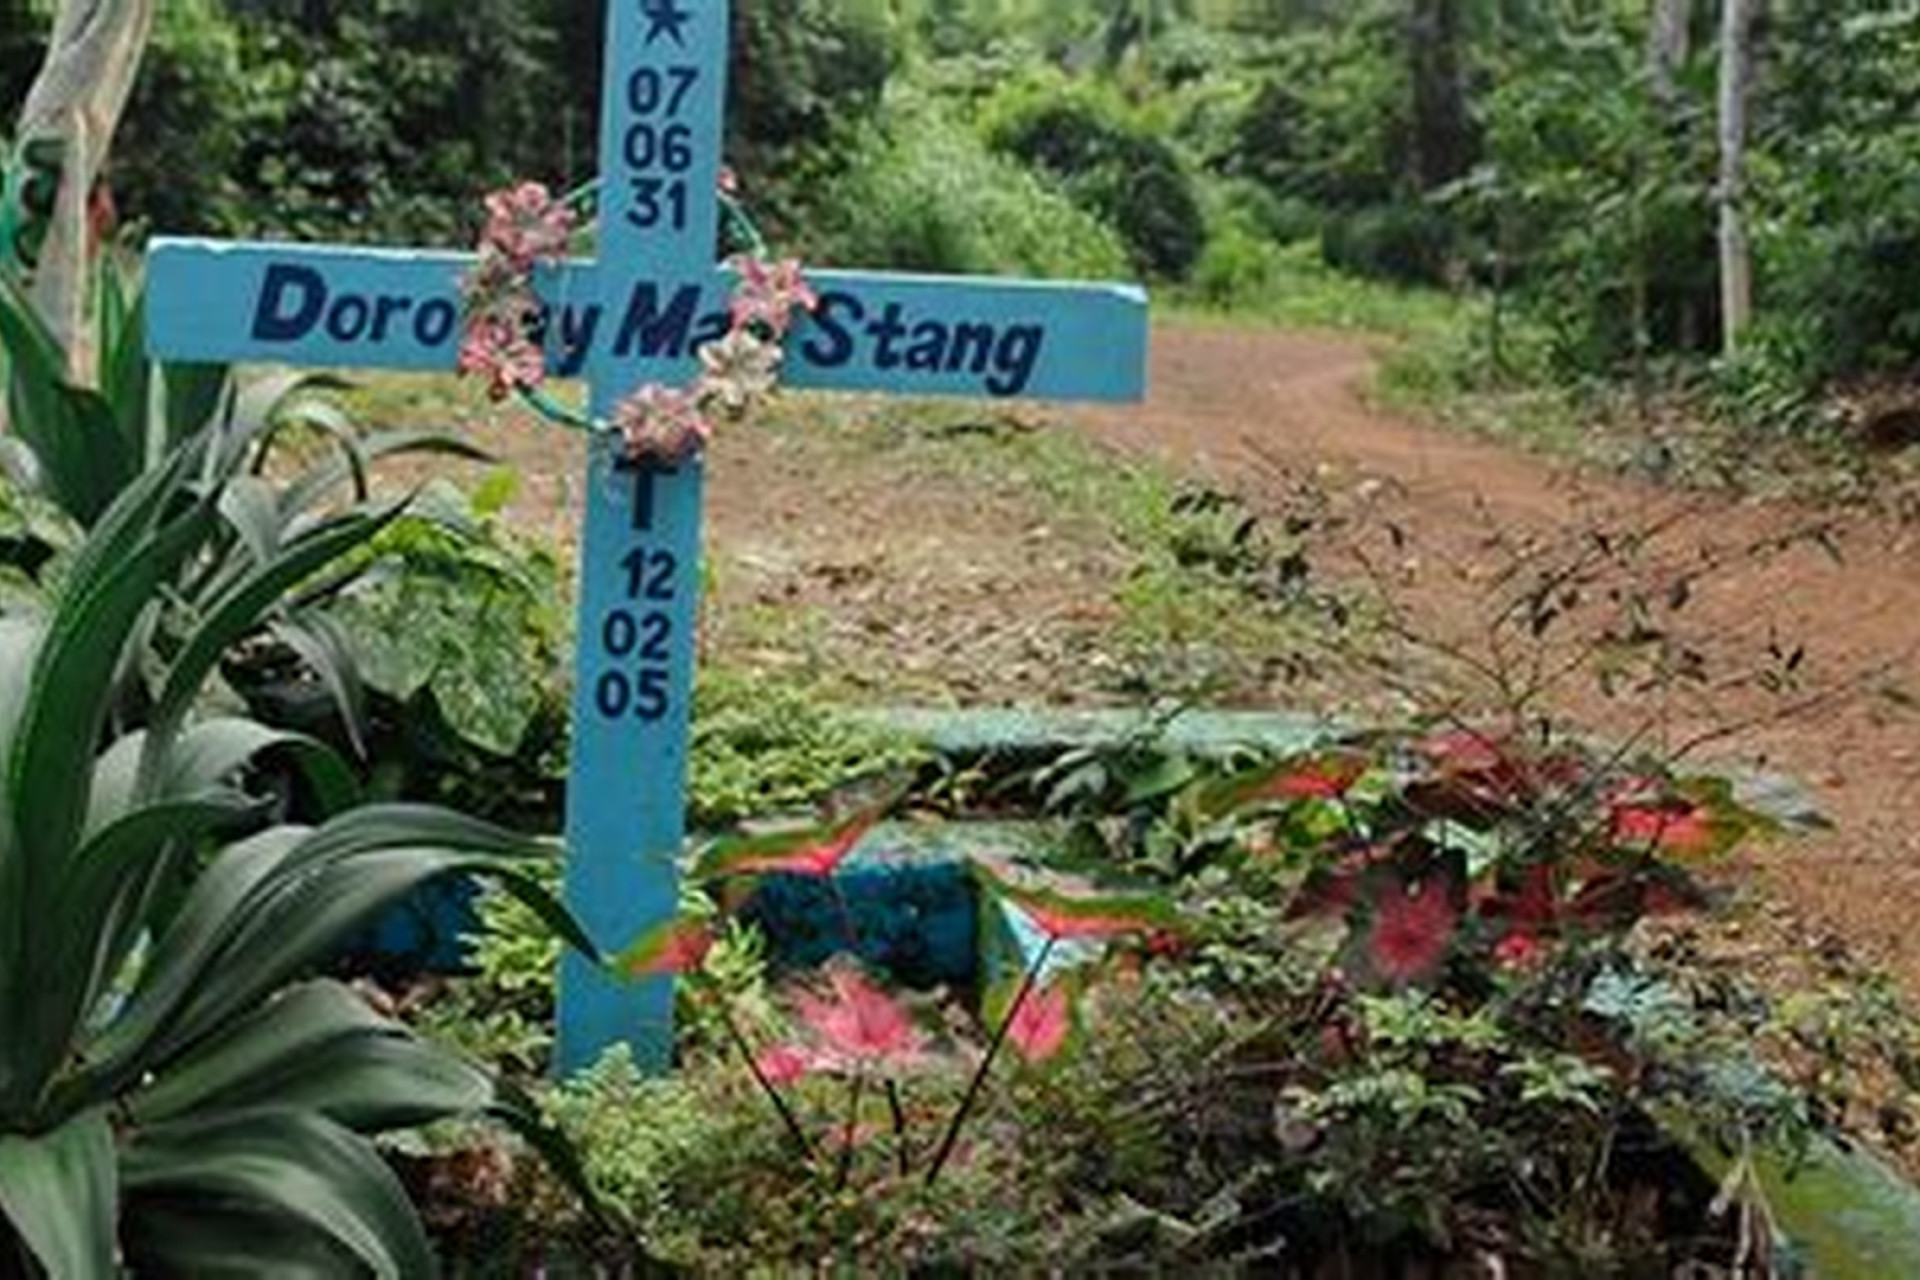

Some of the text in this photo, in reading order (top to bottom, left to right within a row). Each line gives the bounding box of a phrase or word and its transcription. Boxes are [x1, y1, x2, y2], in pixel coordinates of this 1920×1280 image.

[627, 66, 699, 117] 07
[624, 123, 691, 172] 06
[626, 177, 686, 231] 31
[251, 263, 1043, 395] Doroy Ma Stang
[620, 548, 676, 599] 12
[603, 610, 671, 660] 02
[597, 669, 668, 720] 05
